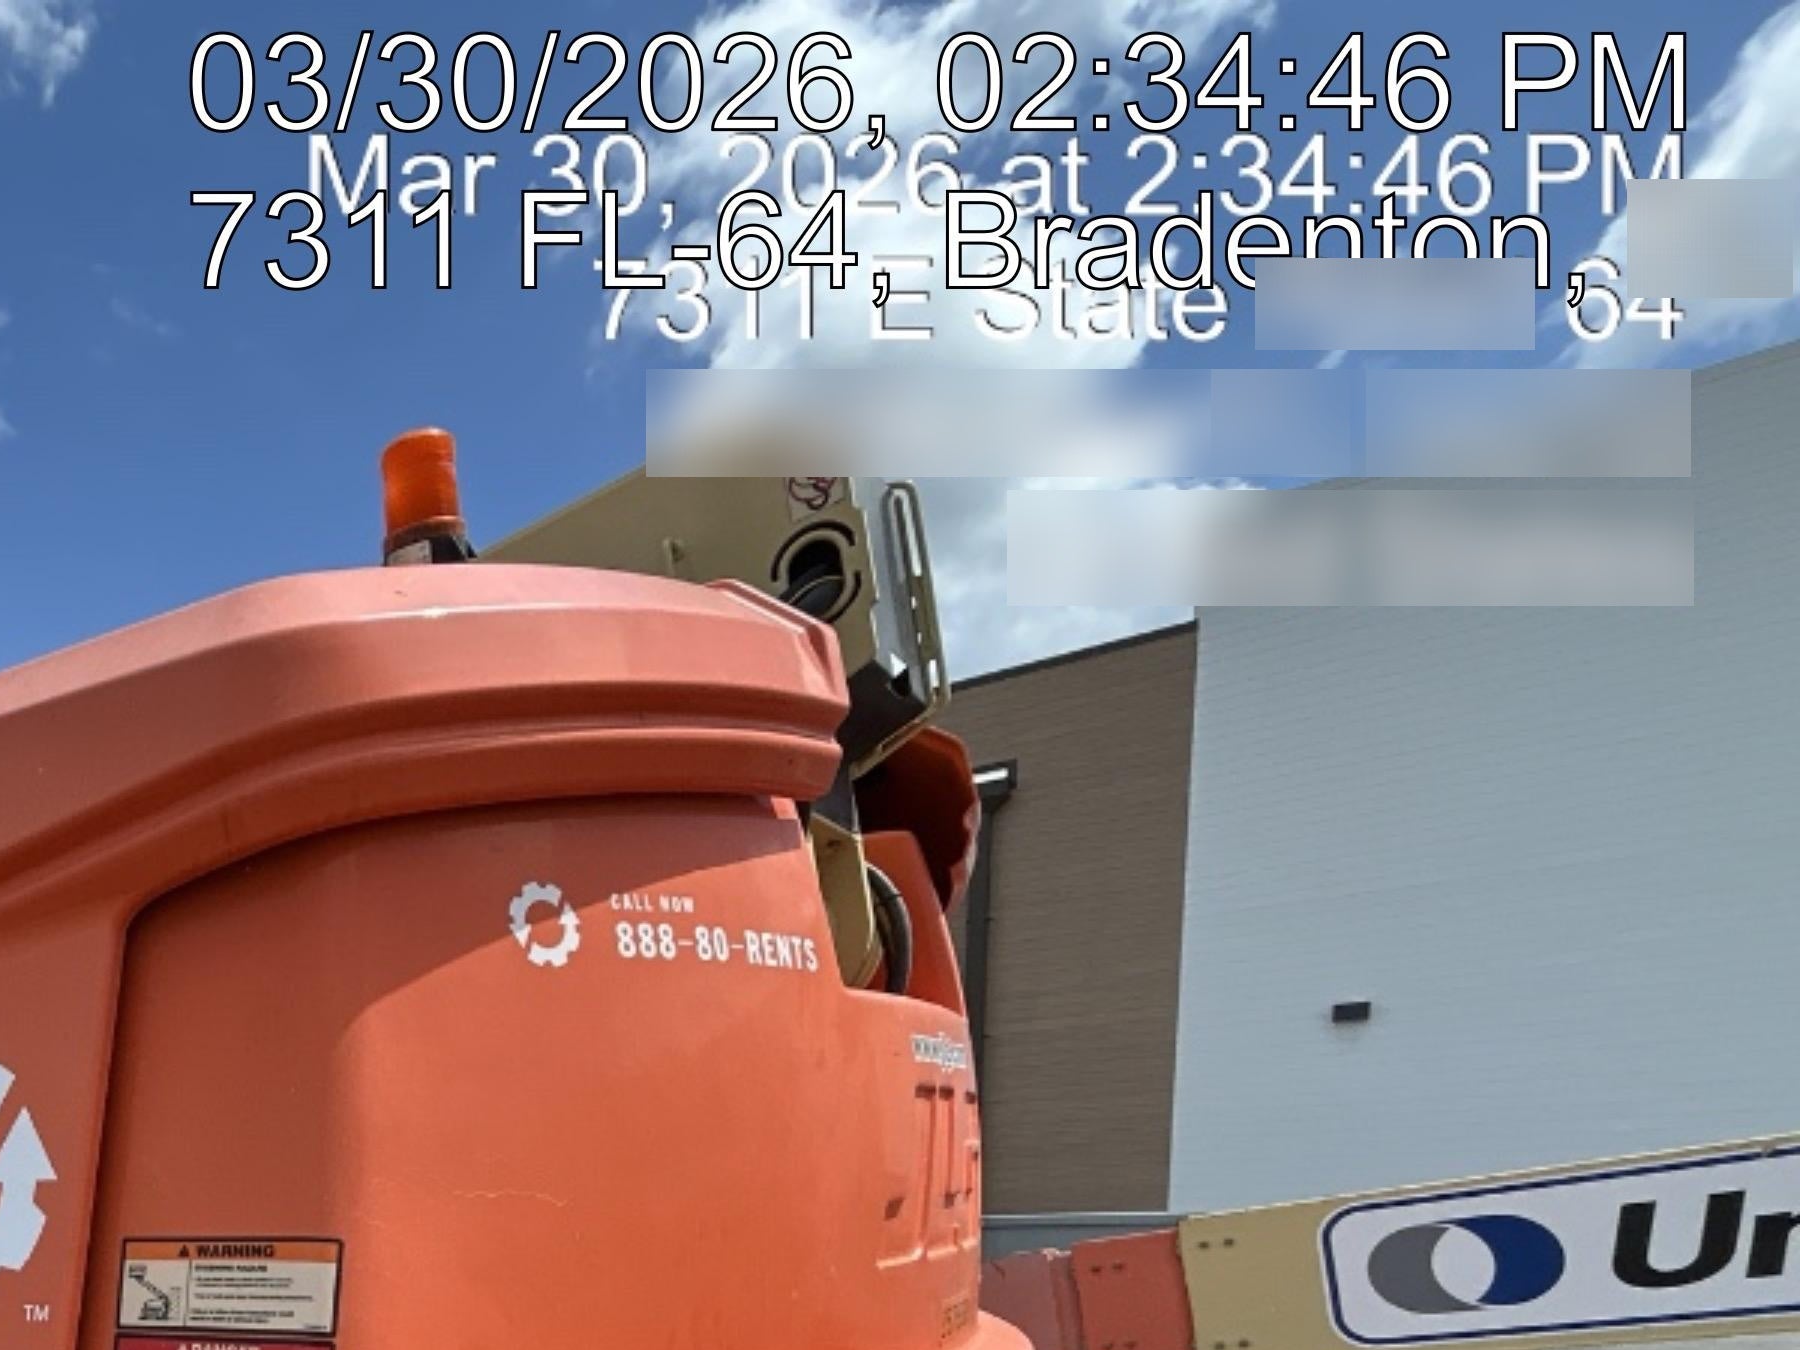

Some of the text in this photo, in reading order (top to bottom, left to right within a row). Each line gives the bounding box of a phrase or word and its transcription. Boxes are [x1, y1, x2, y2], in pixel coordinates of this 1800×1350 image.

[611, 893, 695, 913] CALL NOW
[615, 920, 818, 972] 888-80-RENTS
[196, 1243, 276, 1258] WARNING
[23, 1303, 50, 1322] TM
